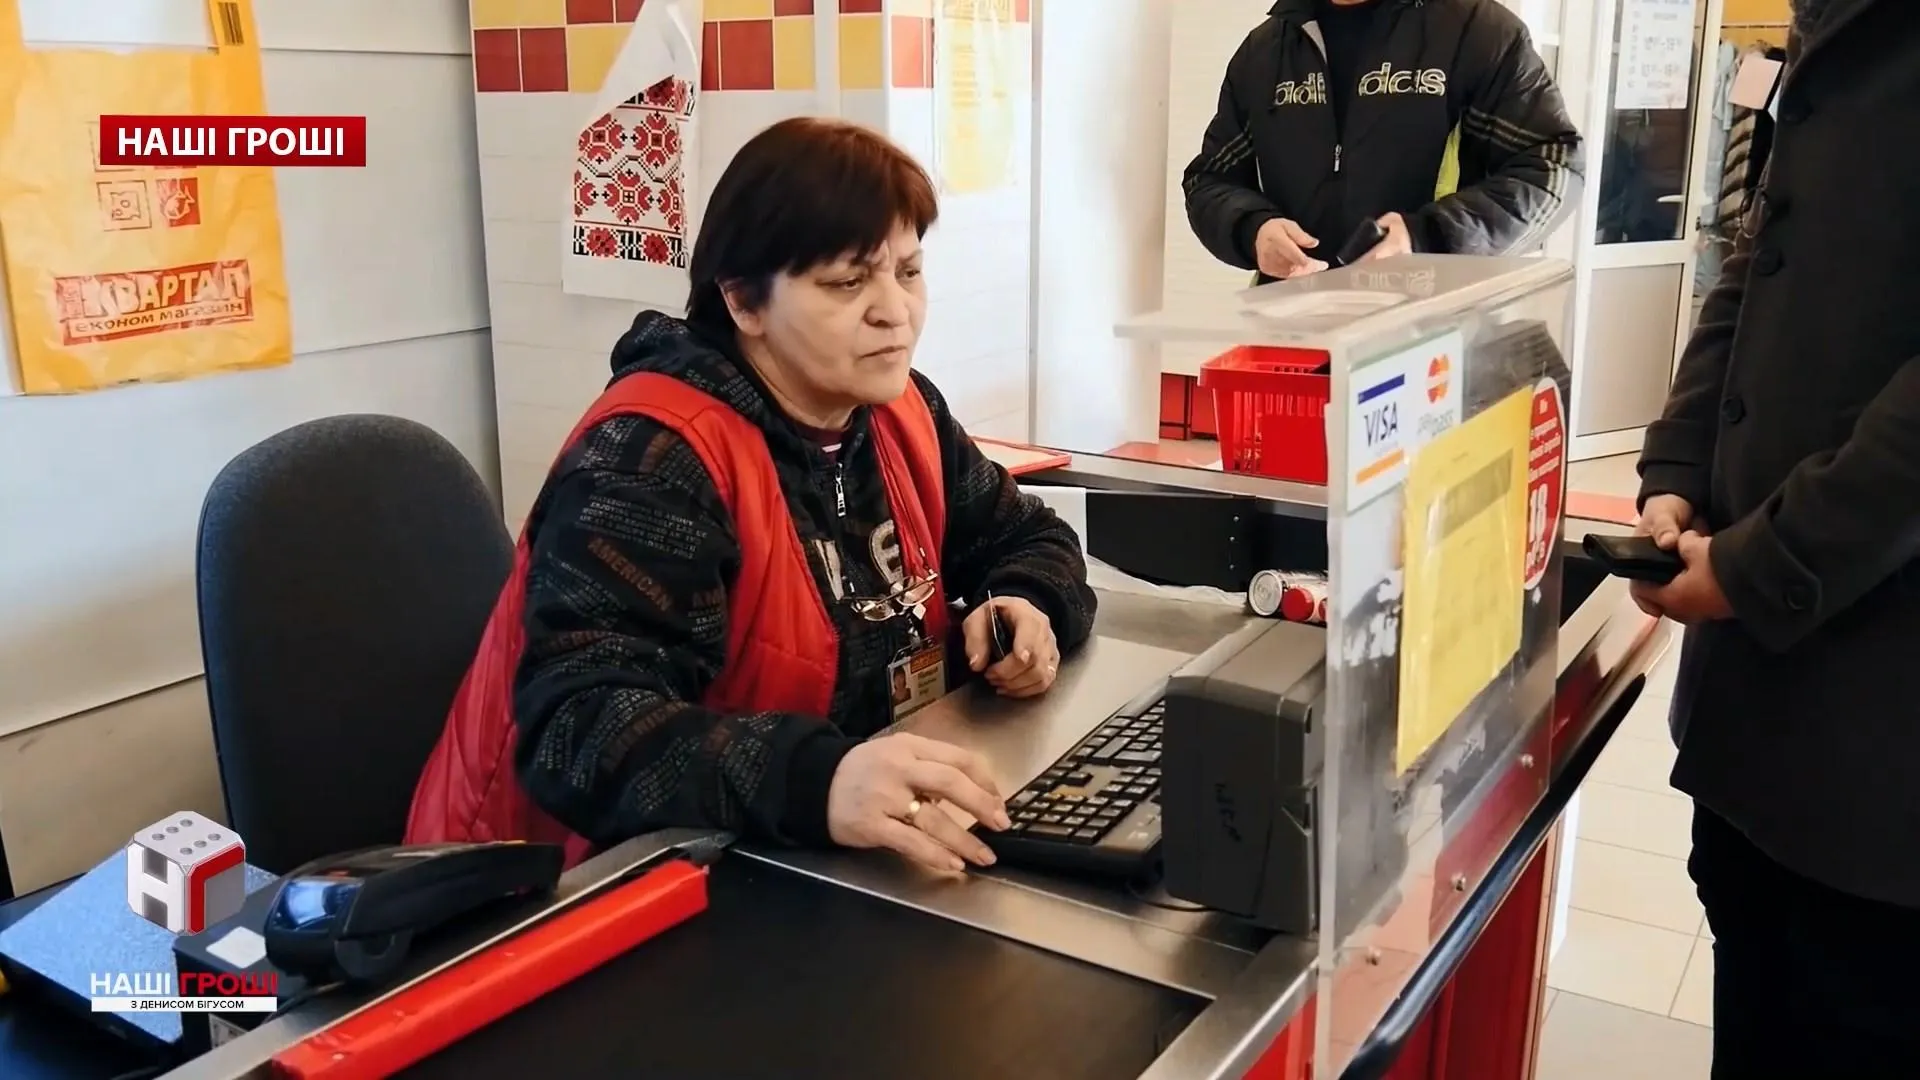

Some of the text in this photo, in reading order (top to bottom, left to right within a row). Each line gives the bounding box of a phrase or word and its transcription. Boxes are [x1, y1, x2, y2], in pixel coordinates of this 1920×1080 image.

[82, 267, 248, 317] КВАРТАЛ
[75, 314, 155, 332] економ
[1363, 401, 1399, 447] VISA
[587, 536, 673, 611] AMERICAN
